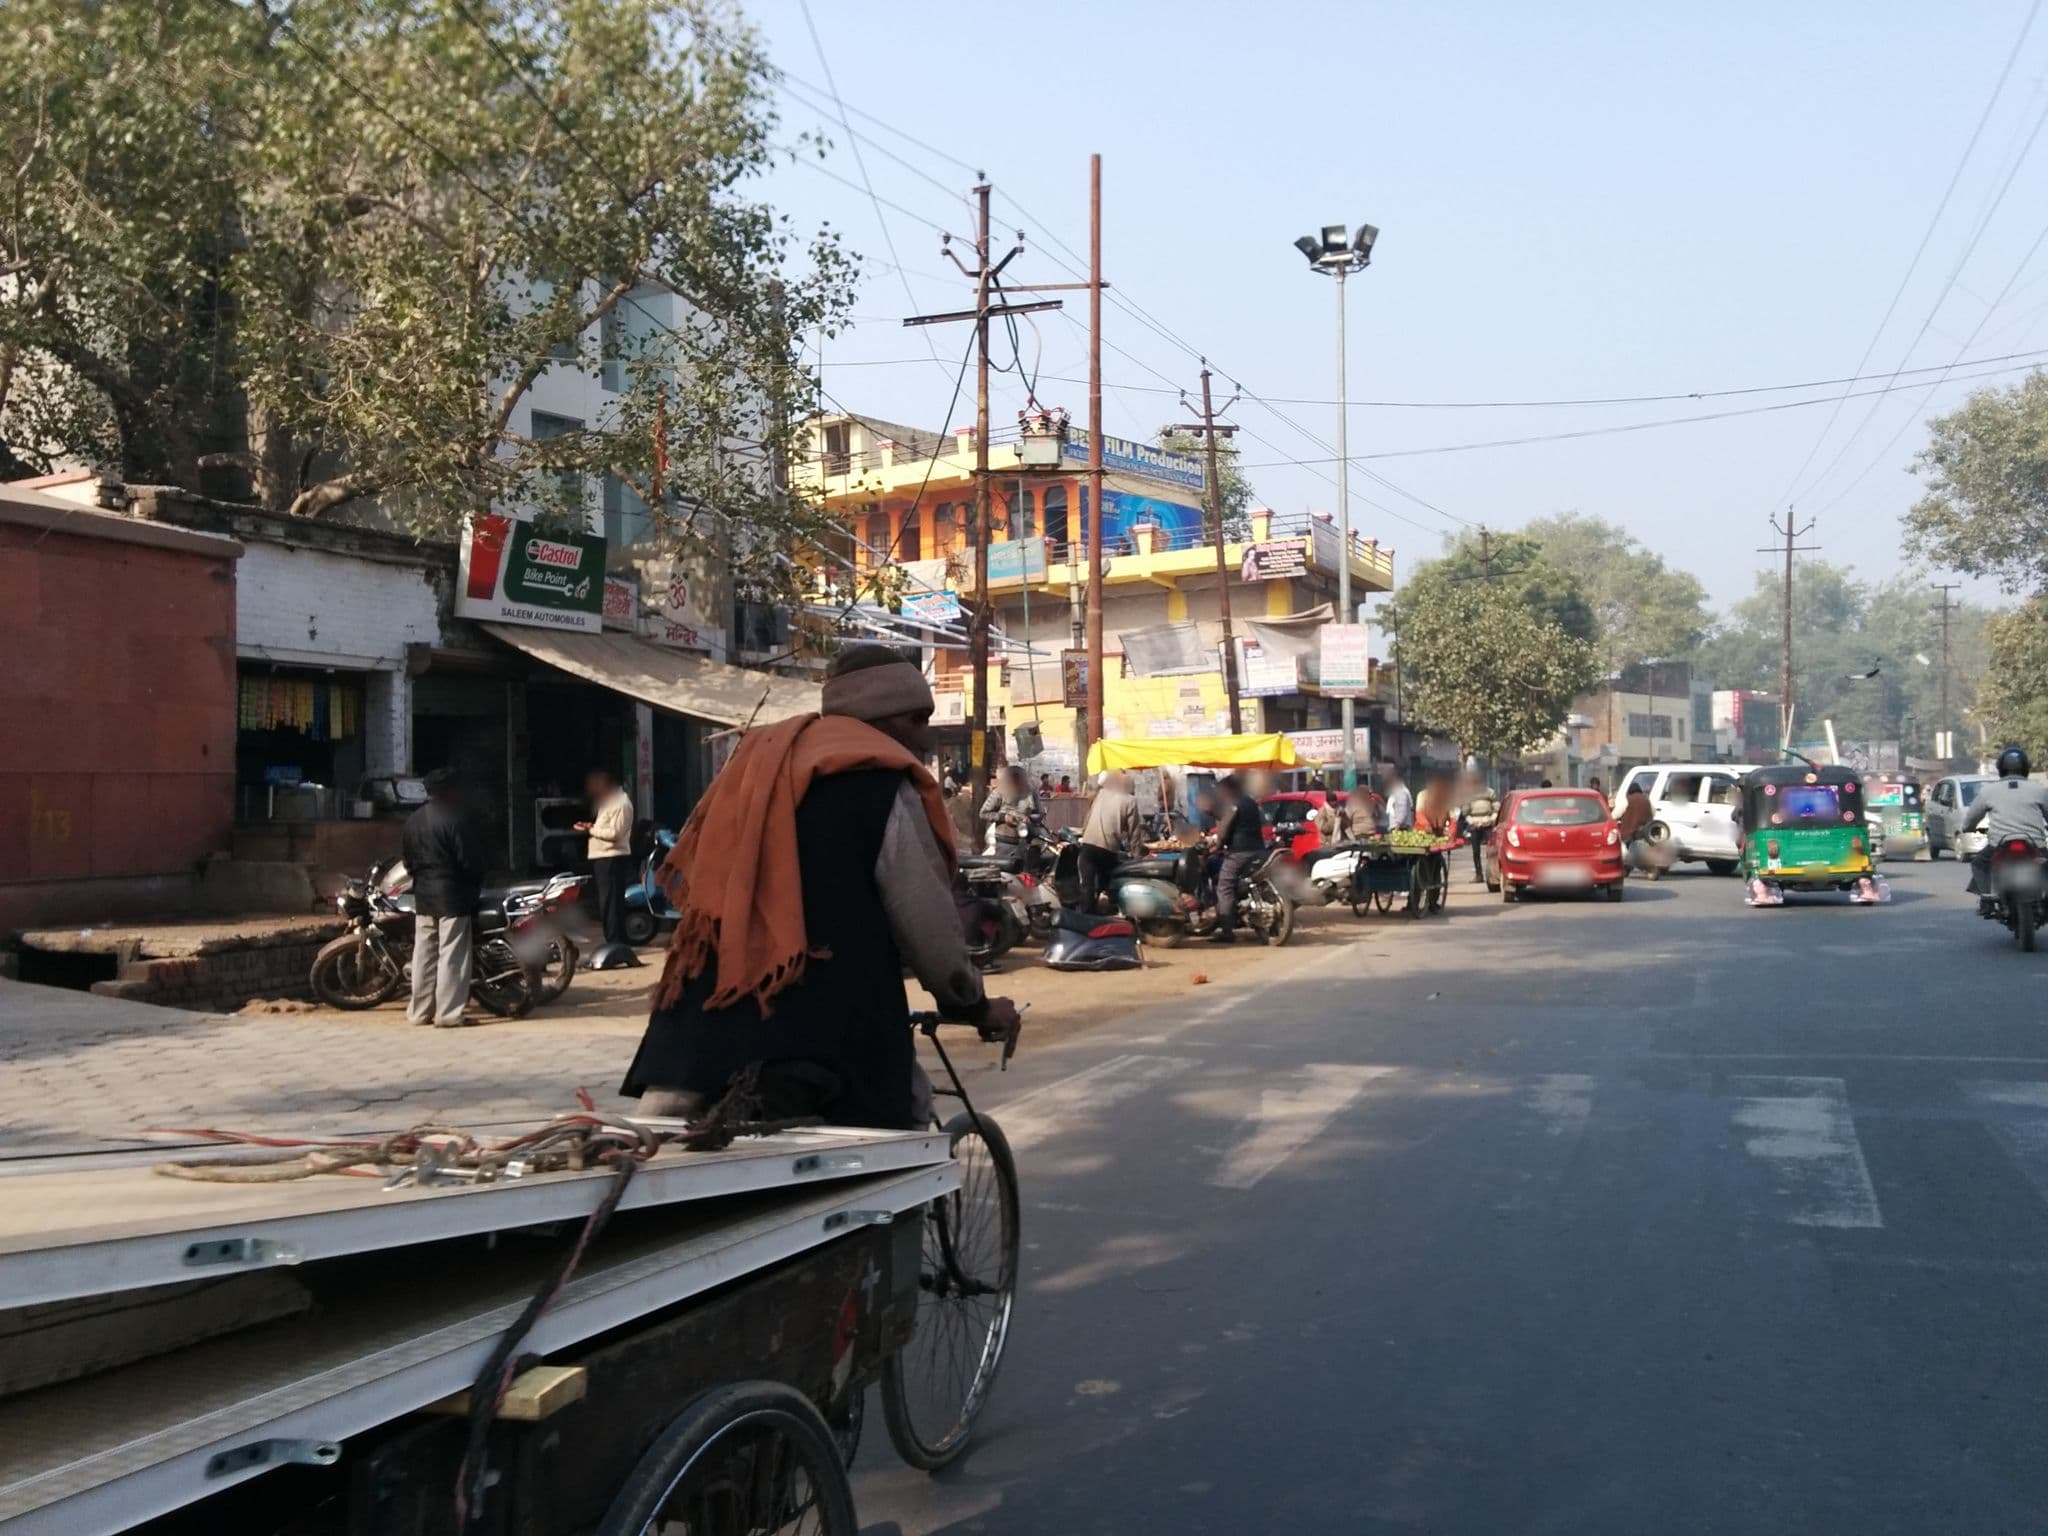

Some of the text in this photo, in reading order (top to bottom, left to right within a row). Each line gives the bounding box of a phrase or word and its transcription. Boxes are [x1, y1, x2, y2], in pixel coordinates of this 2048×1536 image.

[1104, 436, 1134, 460] FILM
[1136, 443, 1203, 477] Production
[540, 543, 579, 567] Castrol
[523, 567, 568, 586] Bike Point
[501, 607, 586, 626] SALEEM AUTOMOBILES
